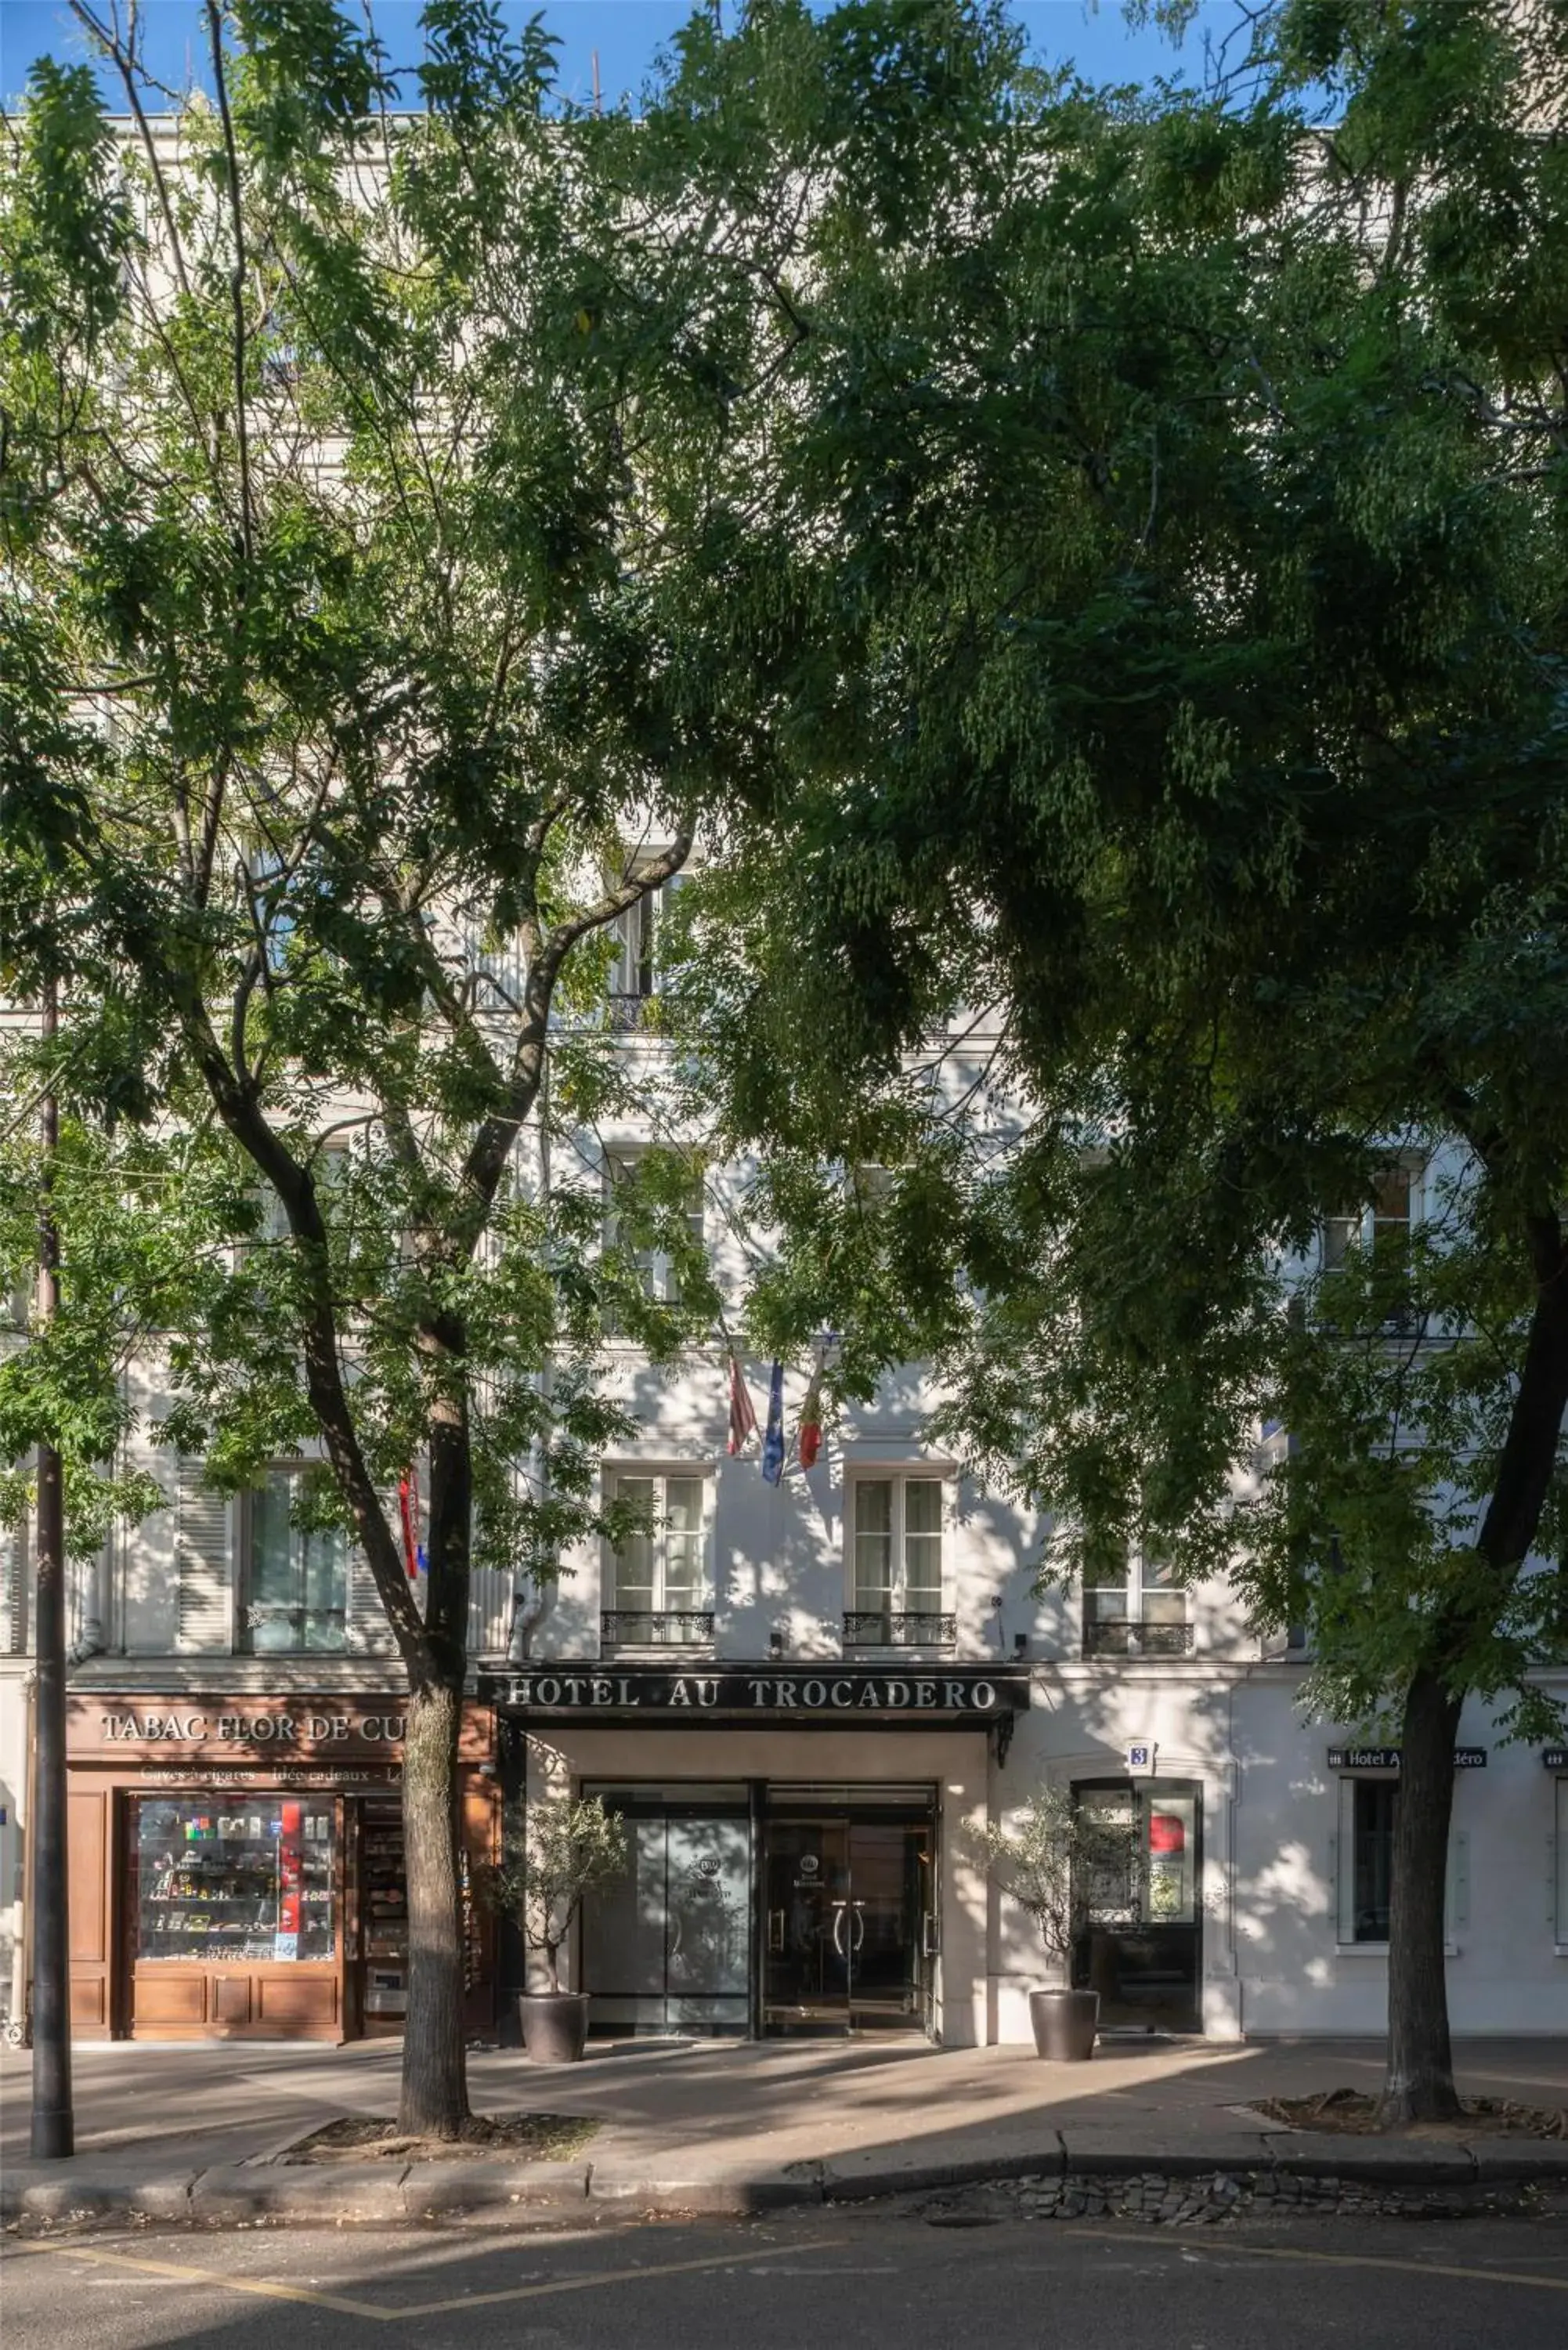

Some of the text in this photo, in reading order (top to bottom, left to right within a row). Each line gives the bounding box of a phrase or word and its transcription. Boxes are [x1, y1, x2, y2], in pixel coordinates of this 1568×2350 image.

[506, 1679, 996, 1708] HOTEL AU TROCADERO
[101, 1714, 407, 1741] TABAC FLOR DE CU
[1134, 1748, 1144, 1763] 3
[1349, 1752, 1385, 1766] Hotel
[310, 1765, 370, 1781] cadeaux
